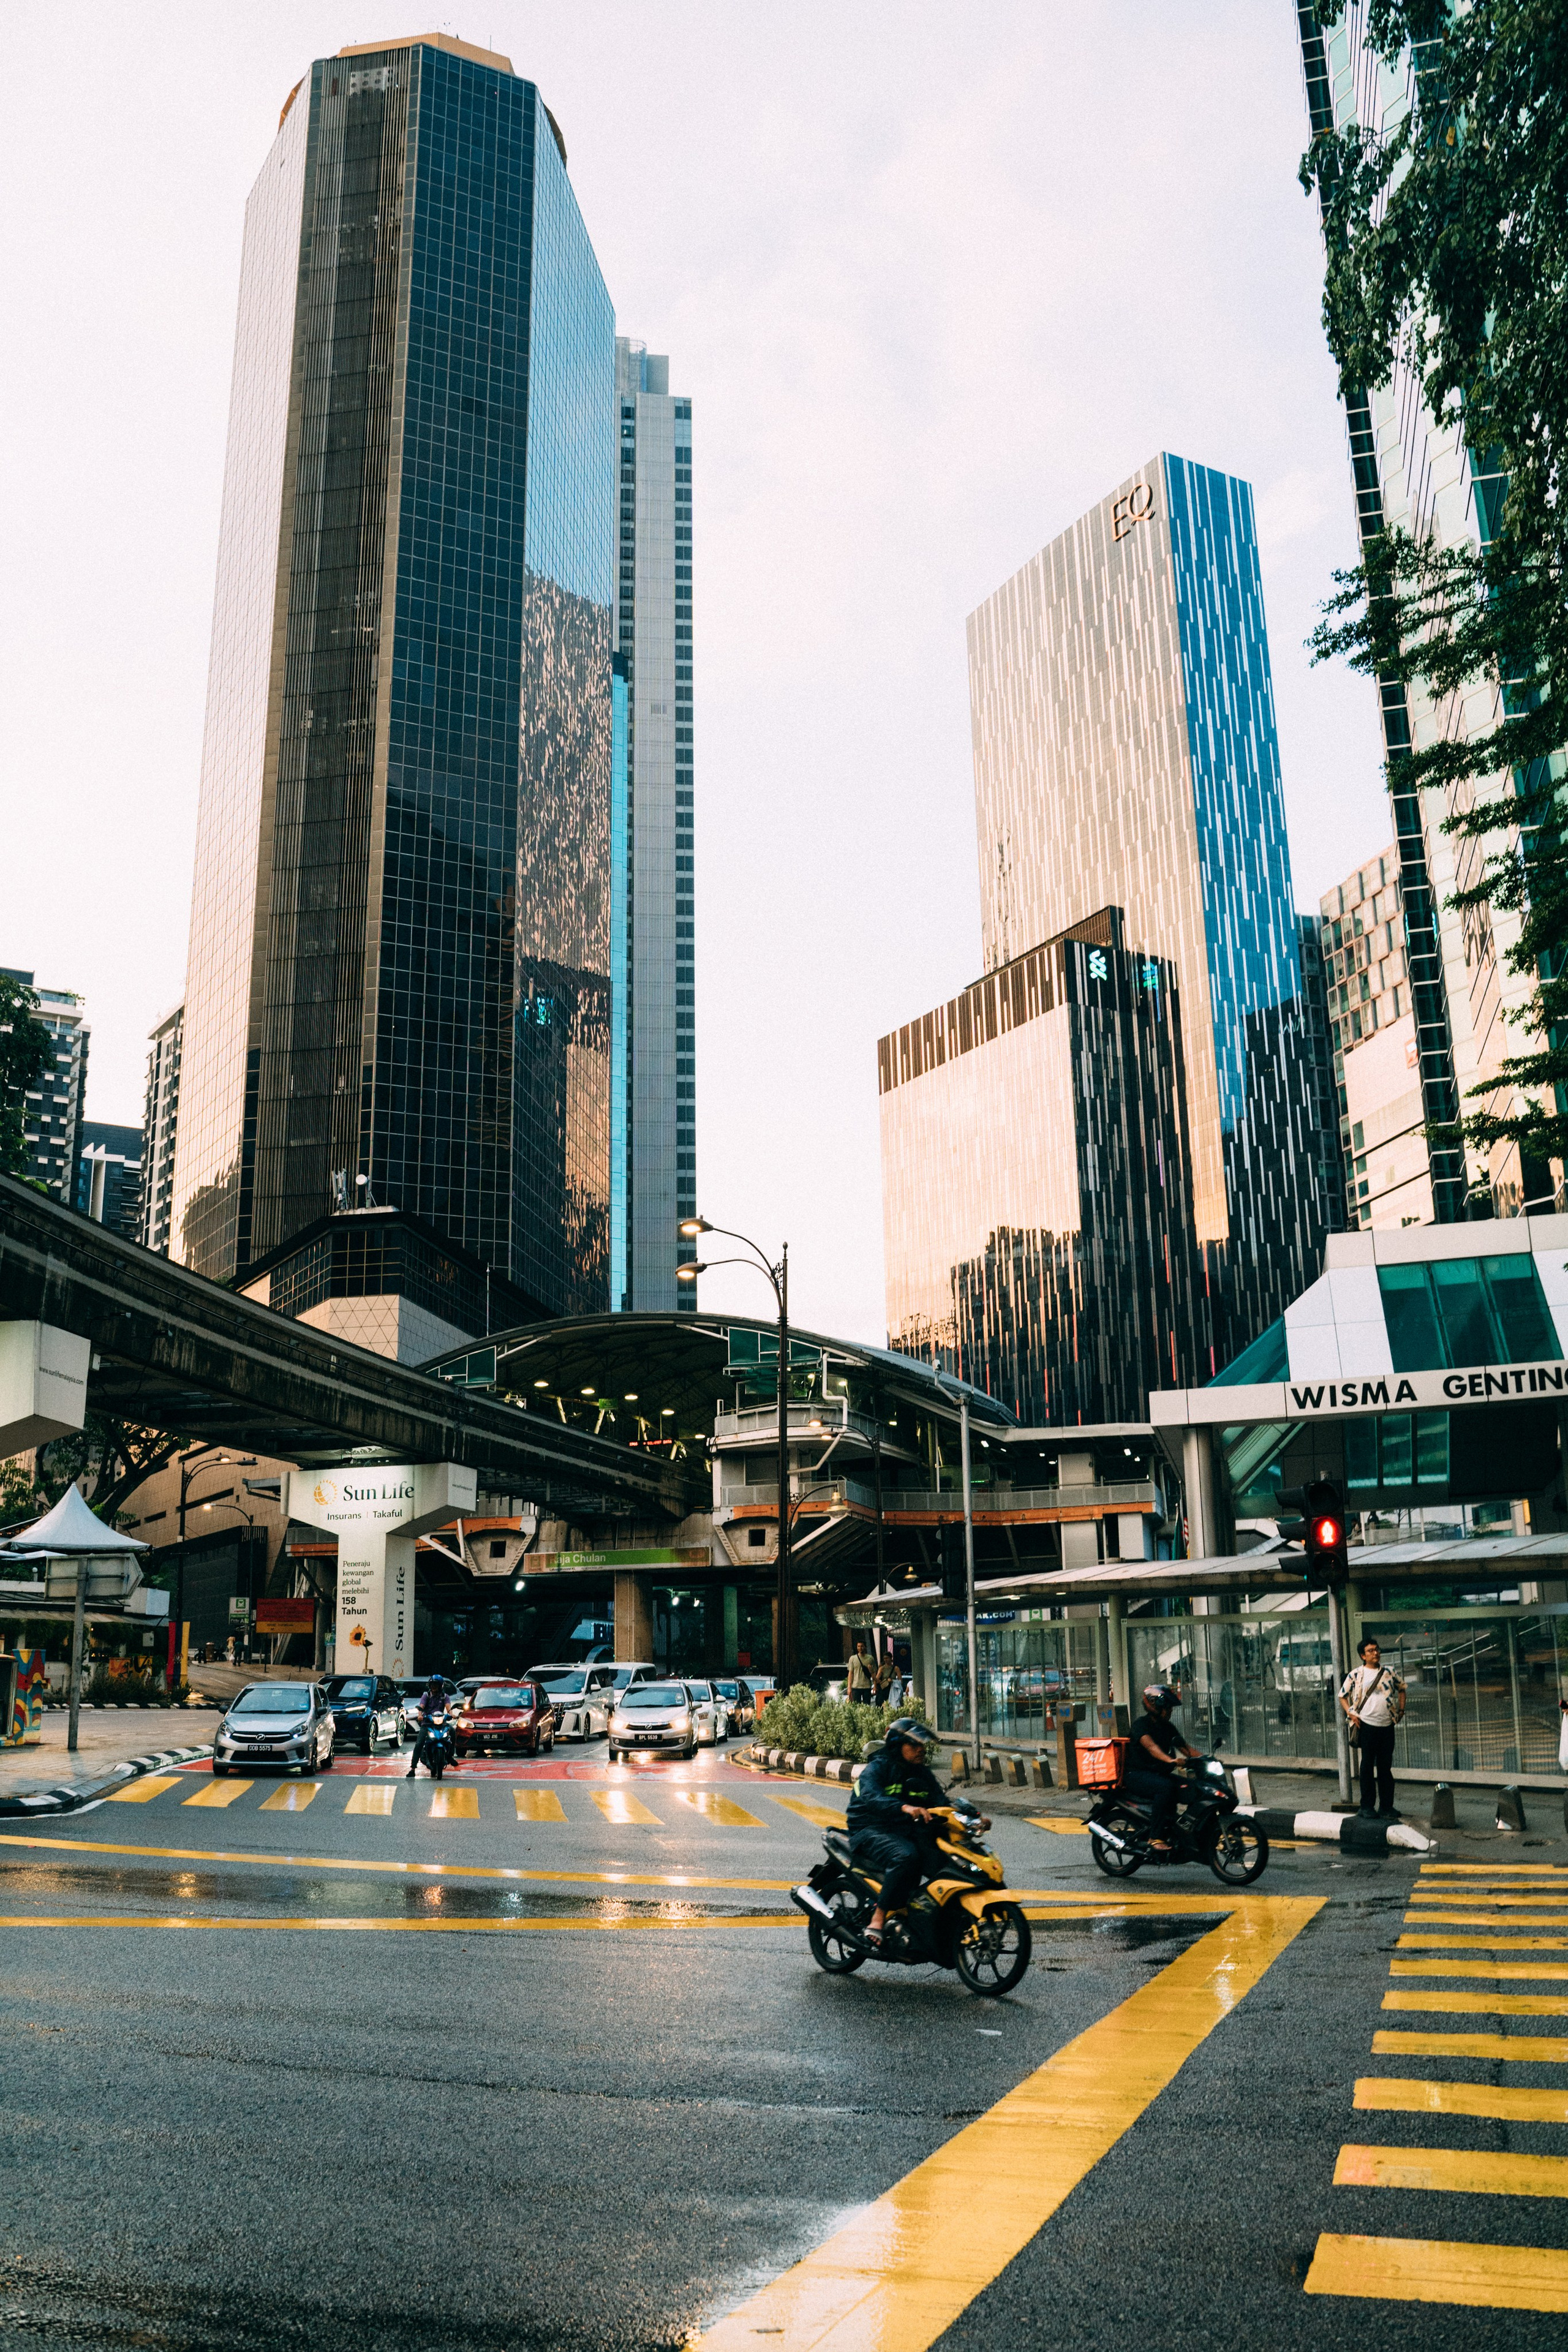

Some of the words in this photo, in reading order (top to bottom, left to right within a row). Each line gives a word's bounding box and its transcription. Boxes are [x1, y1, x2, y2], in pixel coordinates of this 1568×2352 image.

[1110, 483, 1155, 542] EQ
[1291, 1380, 1417, 1409] WISMA
[1443, 1367, 1568, 1398] GENTIN
[343, 1485, 376, 1501] Sun
[382, 1481, 415, 1499] Life
[372, 1509, 402, 1518] Takaful
[573, 1553, 606, 1563] Chulan
[396, 1566, 405, 1606] Life
[395, 1611, 404, 1651] Sun
[1082, 1749, 1106, 1765] 24/7
